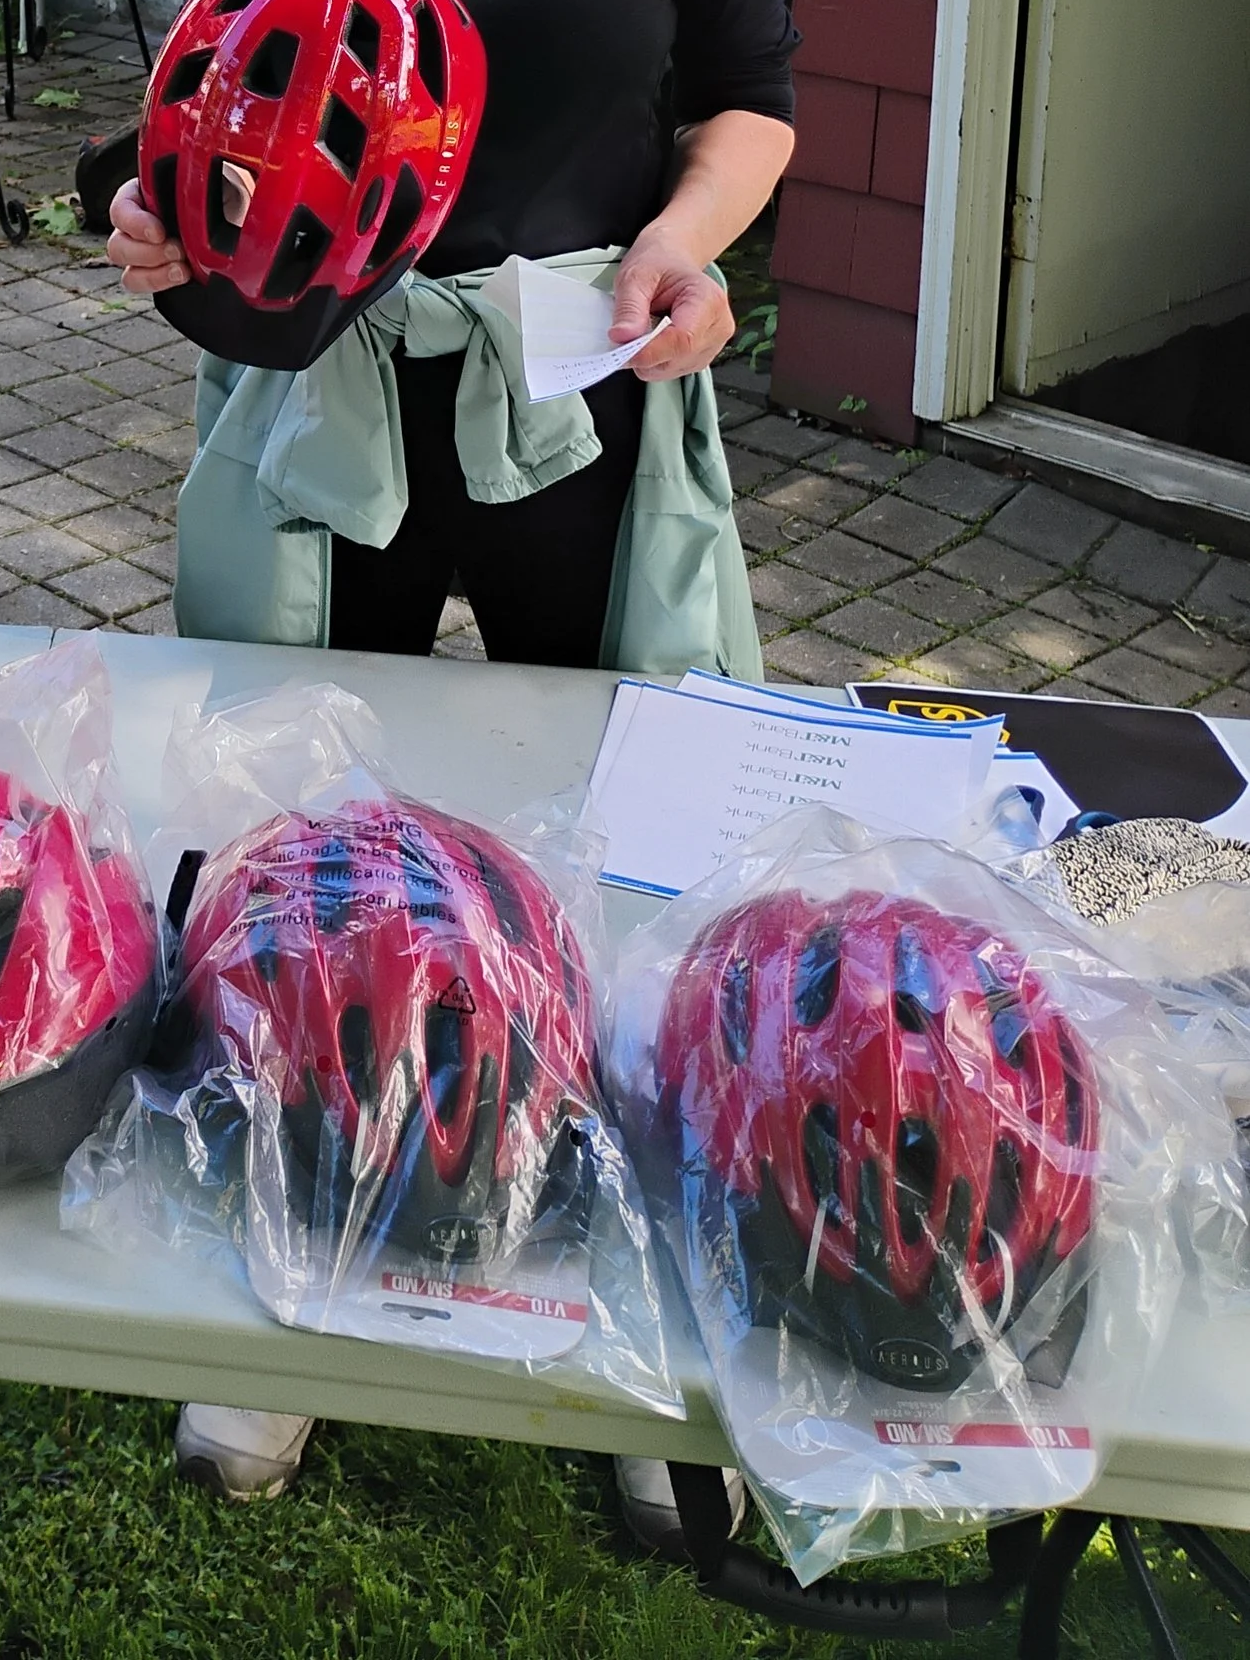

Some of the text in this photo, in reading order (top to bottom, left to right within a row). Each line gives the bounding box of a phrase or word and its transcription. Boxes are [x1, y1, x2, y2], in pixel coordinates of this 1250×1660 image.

[750, 720, 851, 747] M&T Bank
[744, 741, 846, 769] M&T Bank
[738, 762, 841, 790] M&T Bank
[731, 783, 782, 803] Bank
[307, 818, 423, 839] WING
[300, 843, 330, 857] bag
[336, 842, 367, 855] can
[371, 846, 392, 859] be
[311, 867, 407, 883] suffocation
[411, 875, 454, 896] keep
[262, 912, 333, 929] children
[390, 1274, 567, 1318] V10 SM/MD
[885, 1422, 1074, 1447] V10 SM/MD
